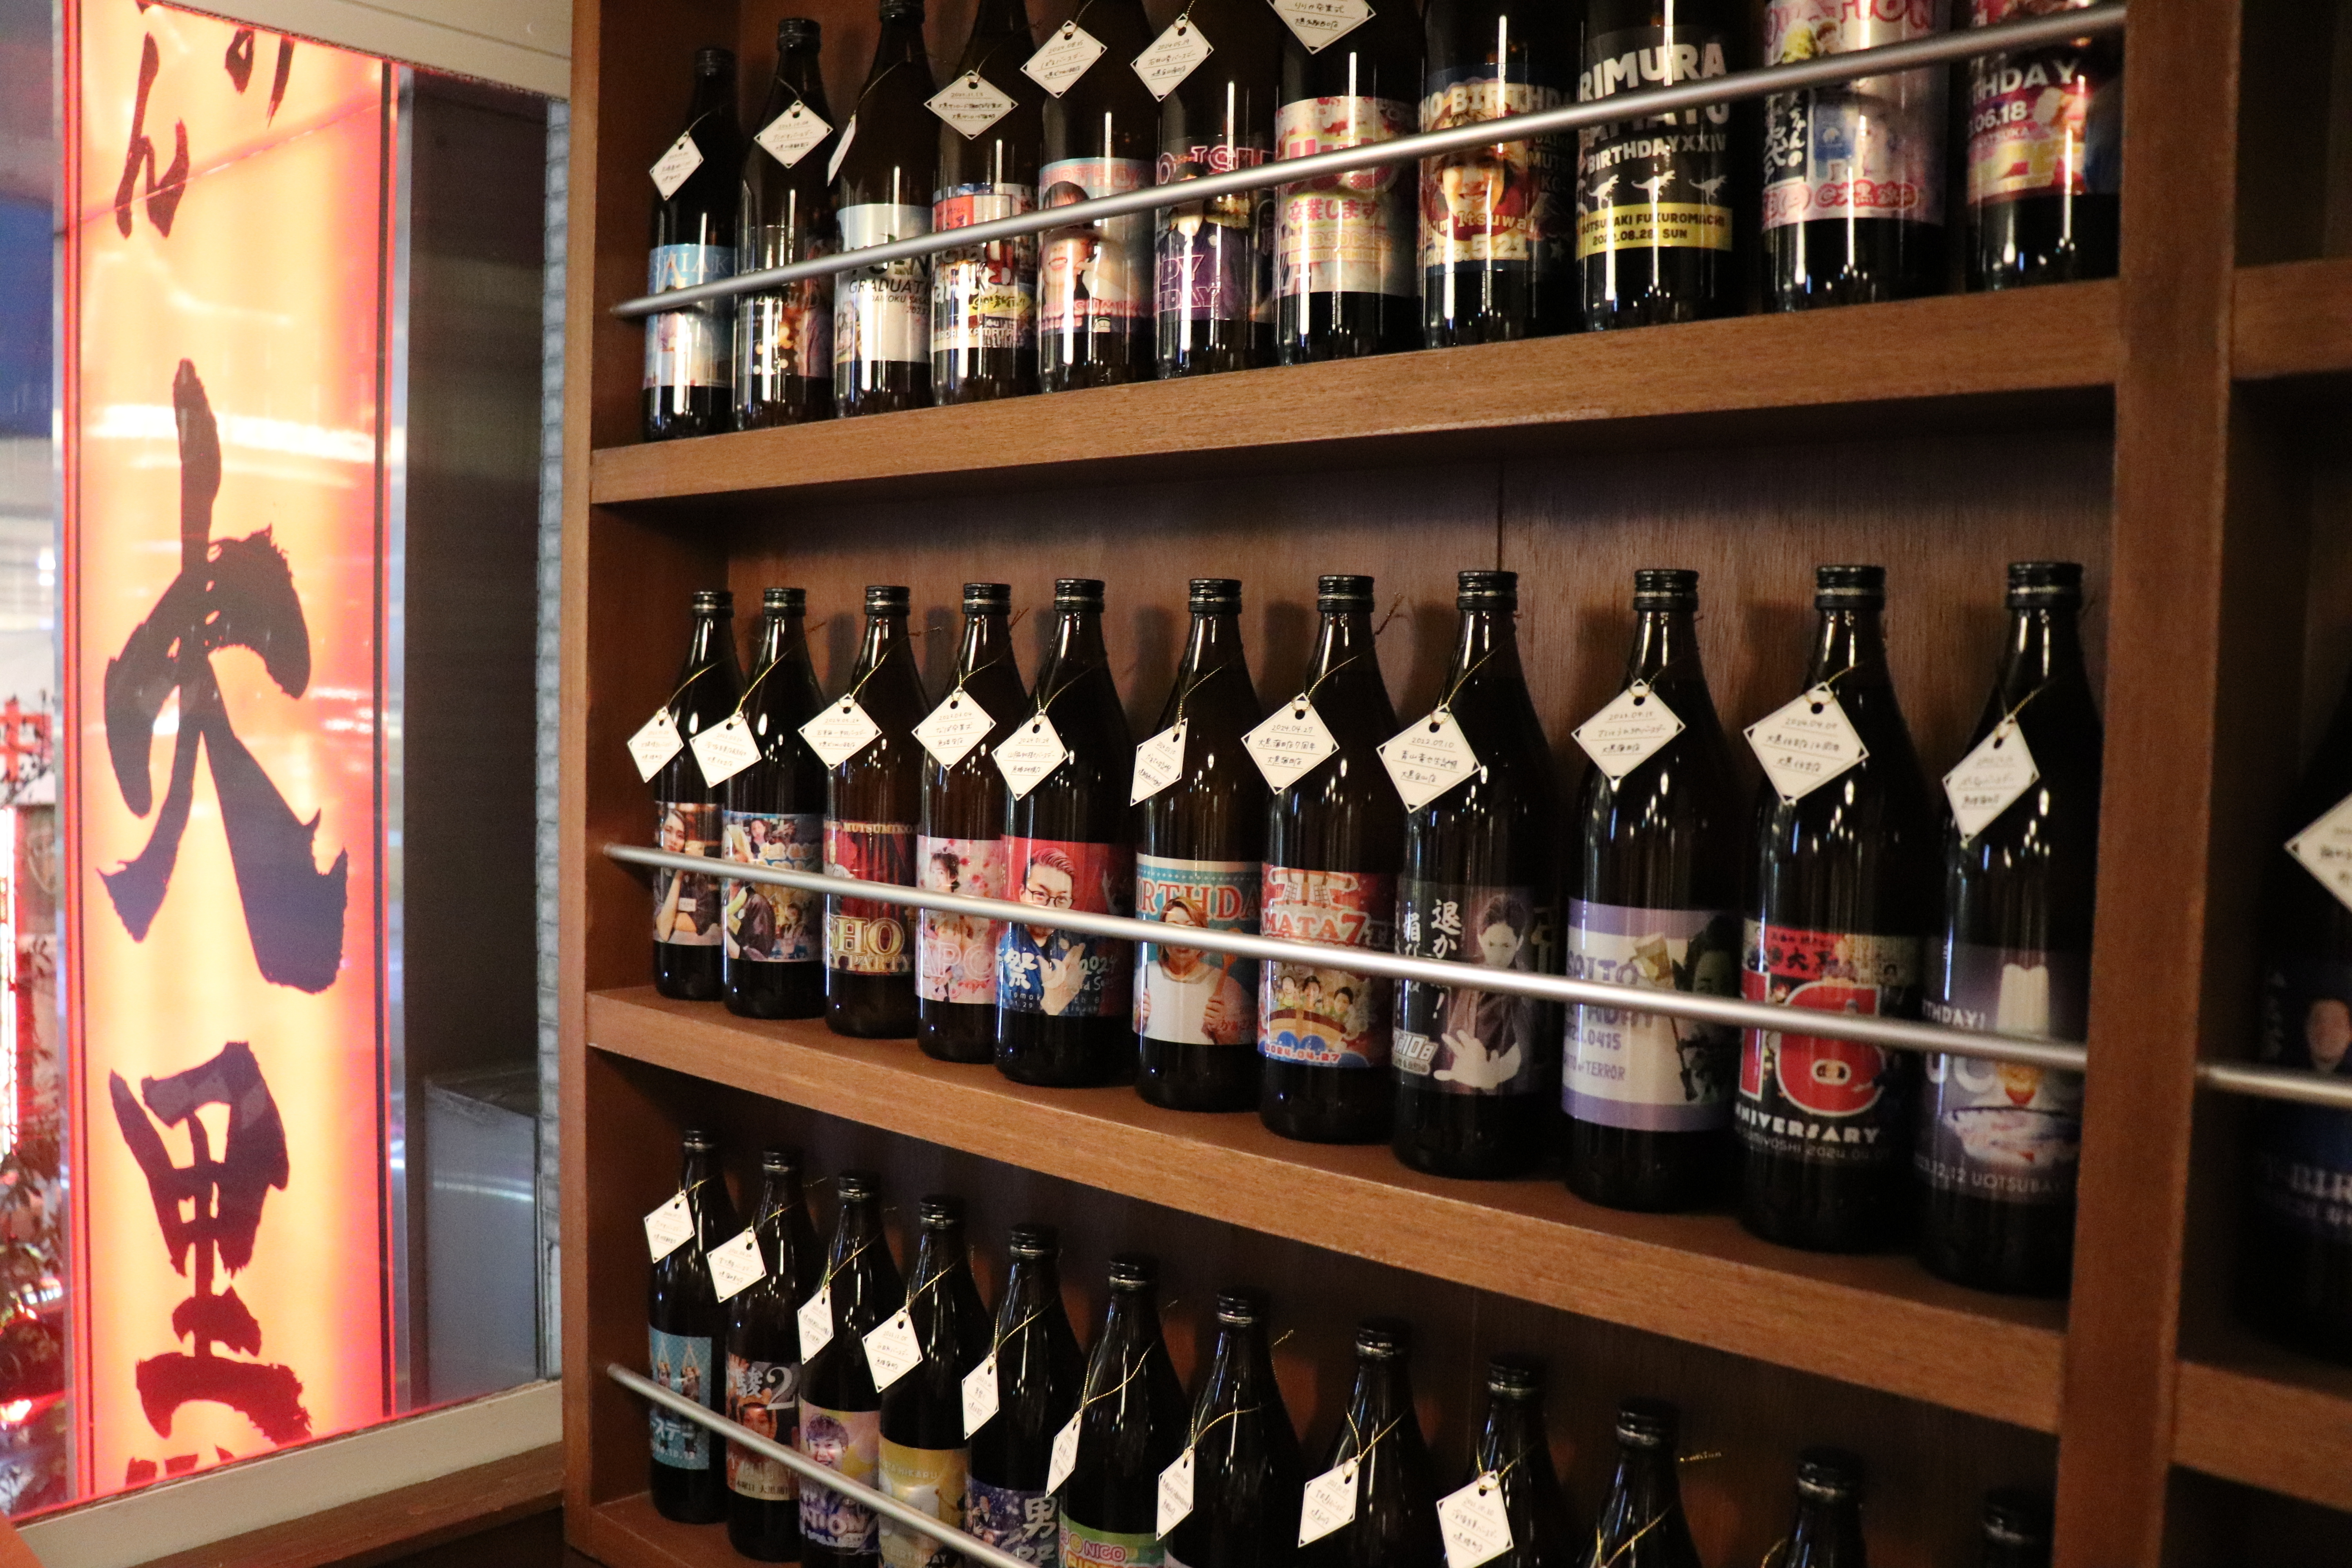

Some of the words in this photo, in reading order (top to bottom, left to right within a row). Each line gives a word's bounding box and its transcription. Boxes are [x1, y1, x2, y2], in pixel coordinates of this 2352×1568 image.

[1289, 199, 1377, 223] 卒業します
[1663, 228, 1688, 240] SUN
[1272, 724, 1313, 734] 2024.04.27
[1267, 755, 1302, 767] 大黒蒲田店
[847, 955, 913, 972] PARTY
[1586, 1061, 1626, 1081] TERROR
[1082, 1541, 1127, 1563] NICO
